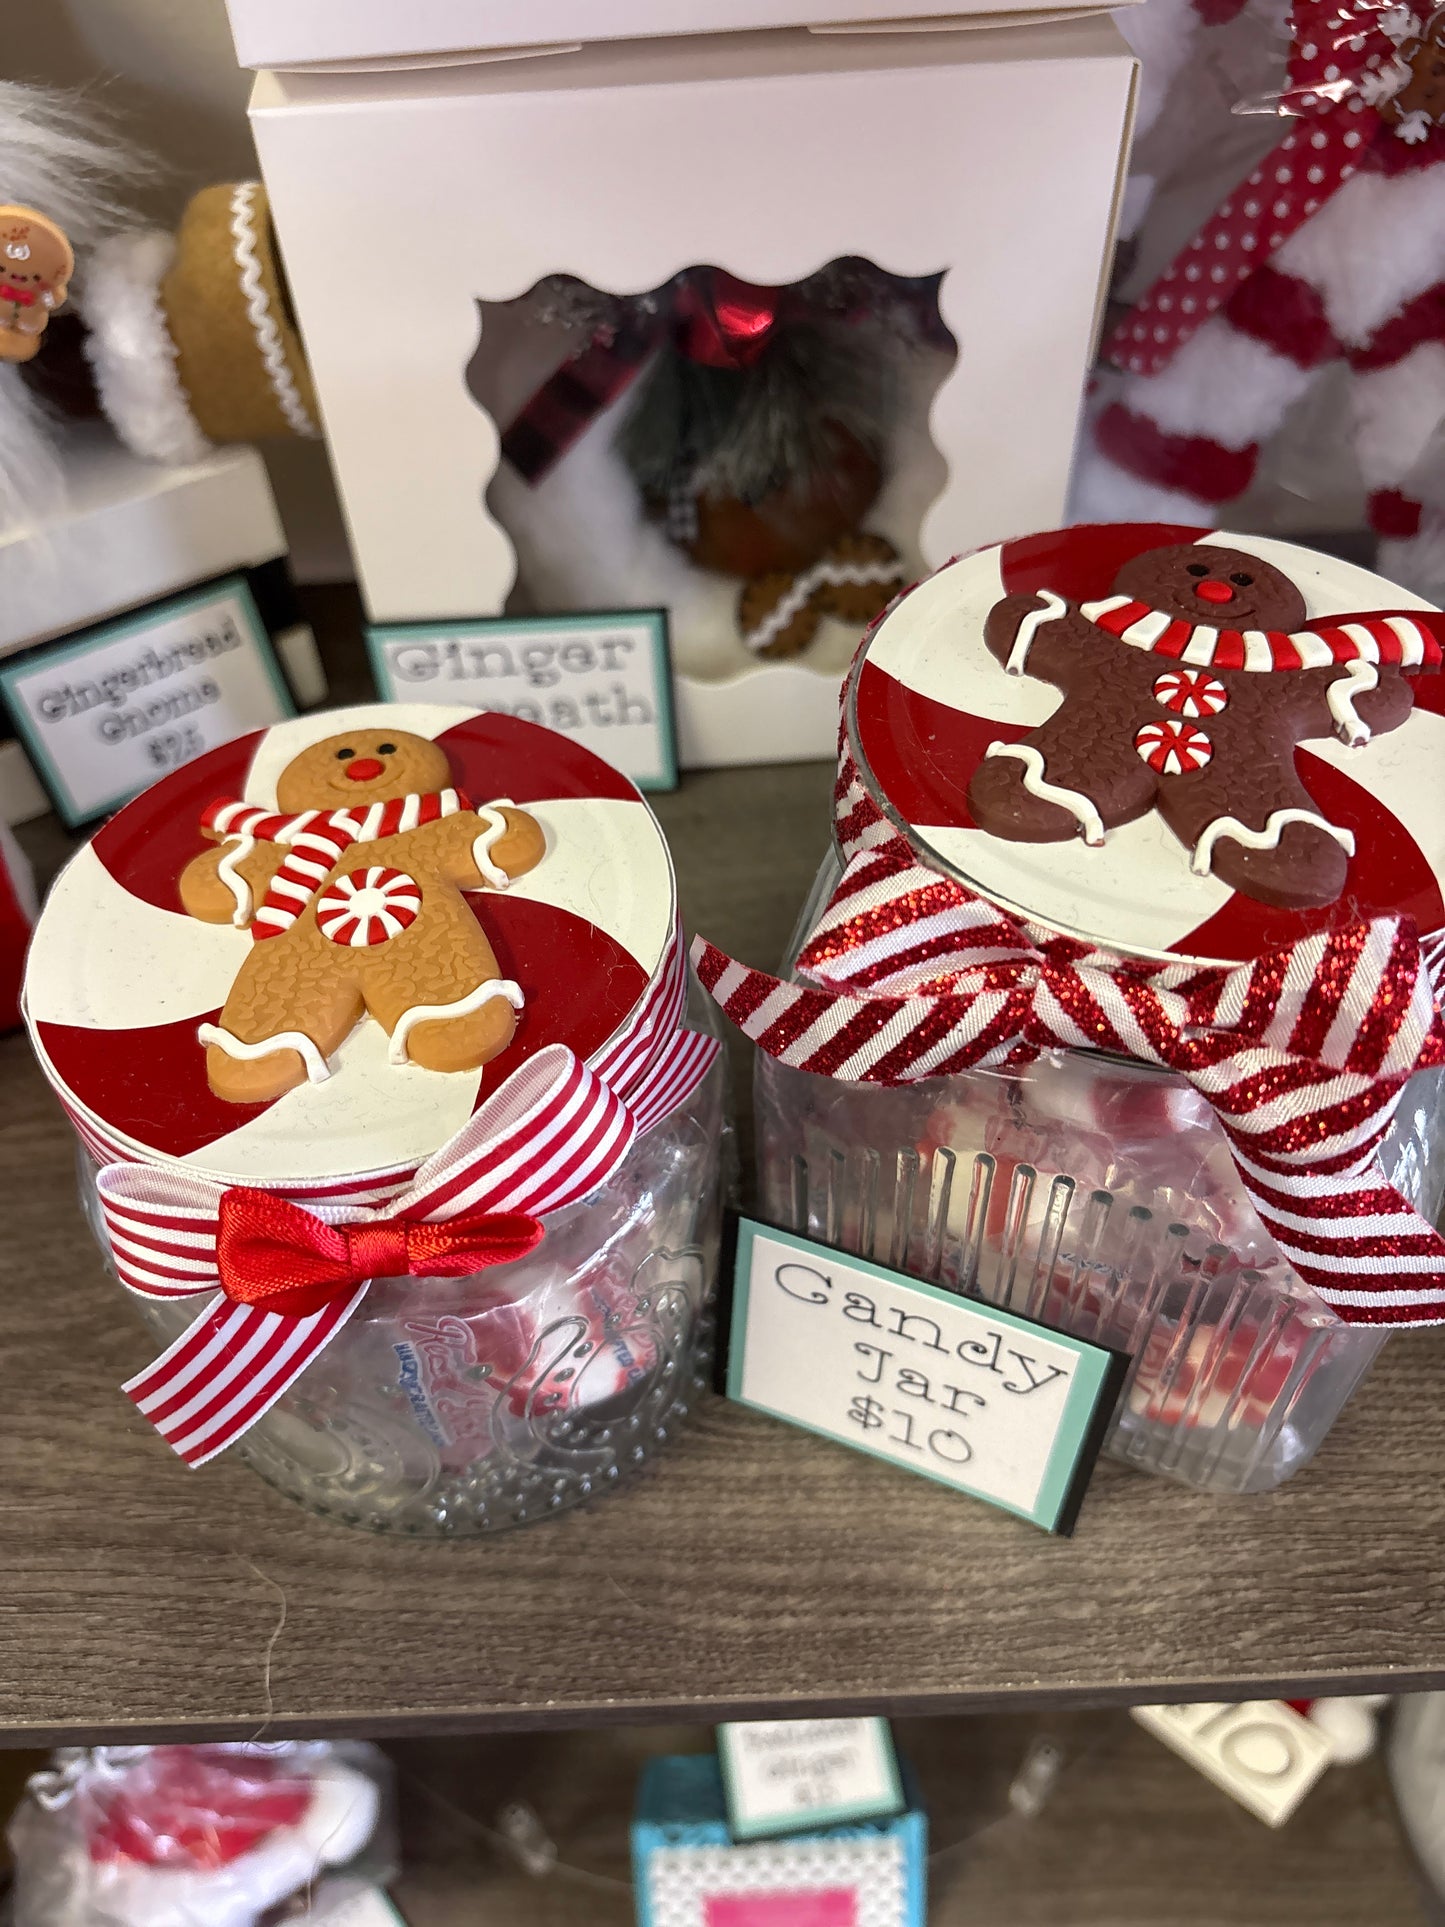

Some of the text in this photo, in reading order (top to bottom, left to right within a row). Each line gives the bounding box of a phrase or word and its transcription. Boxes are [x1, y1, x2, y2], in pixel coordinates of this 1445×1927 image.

[37, 616, 241, 724] Gingerbread
[391, 638, 636, 688] Ginger
[98, 676, 222, 746] Gnome
[775, 1263, 1068, 1395] Candy
[853, 1342, 986, 1417] Jar
[846, 1395, 973, 1464] $10
